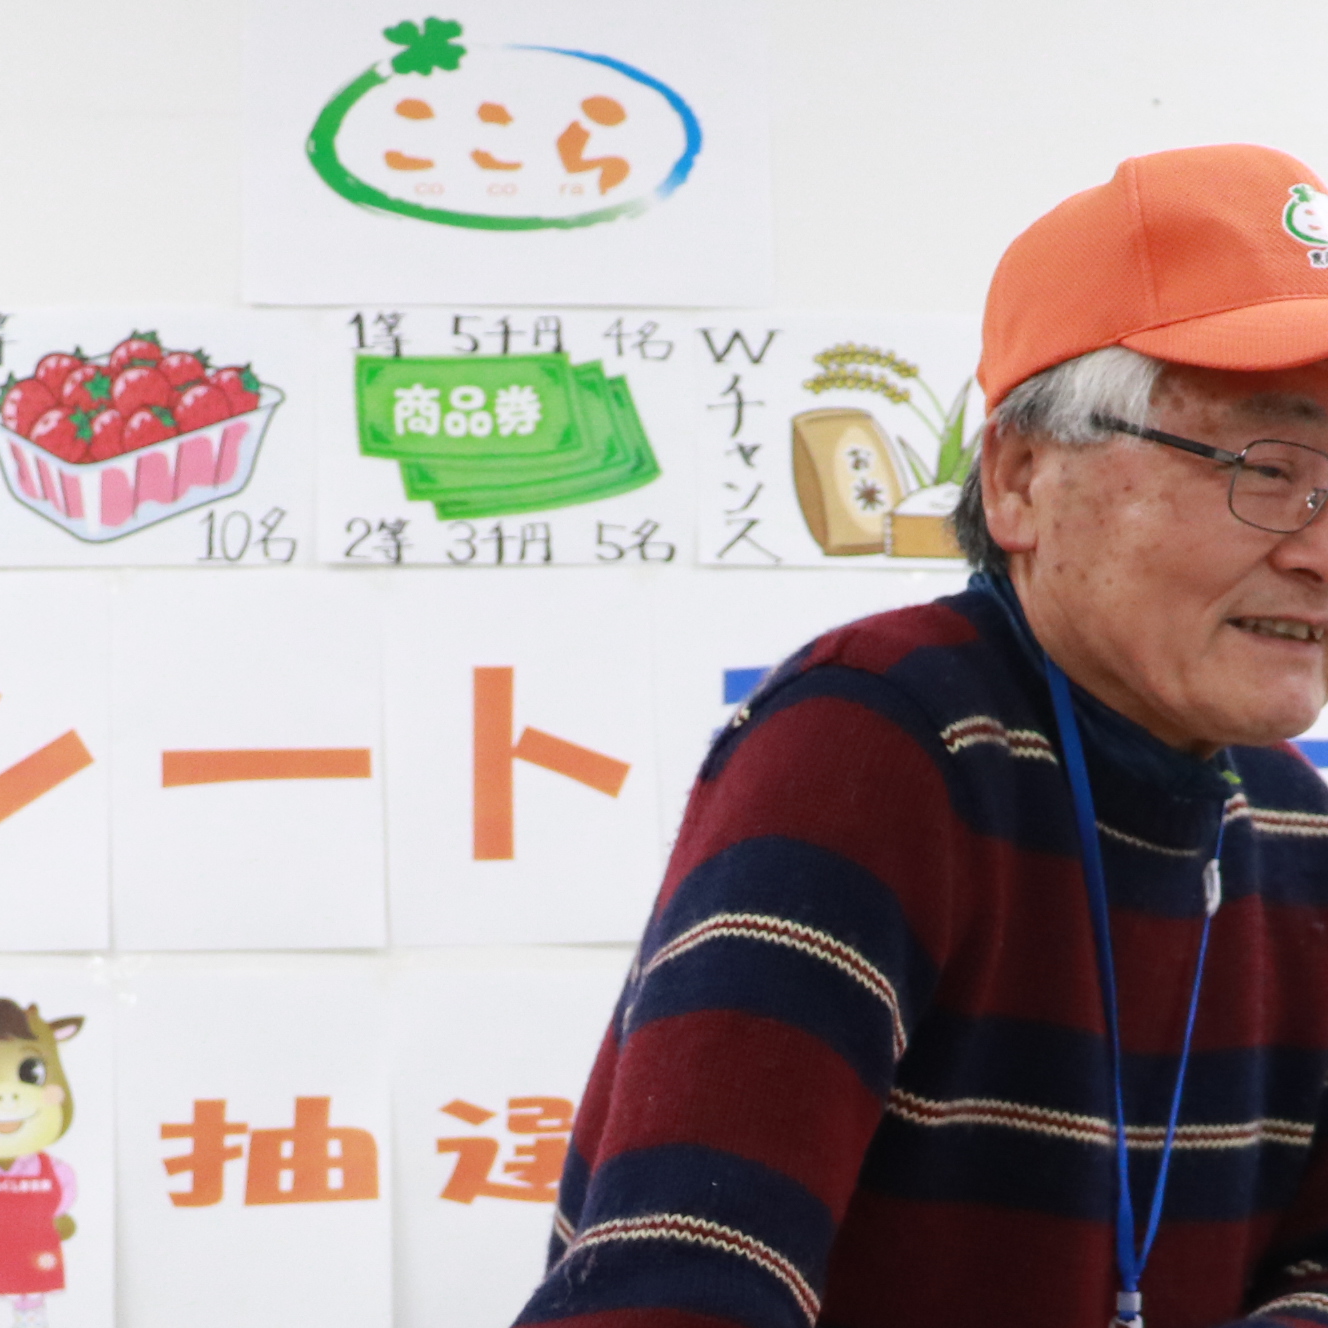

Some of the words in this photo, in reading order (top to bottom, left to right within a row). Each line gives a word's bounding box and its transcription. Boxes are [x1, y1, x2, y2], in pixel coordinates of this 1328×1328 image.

[383, 95, 630, 196] ここら
[414, 183, 445, 196] co
[486, 183, 518, 196] co
[348, 312, 410, 357] 1等
[451, 315, 563, 355] 5千円
[603, 317, 674, 360] 4名
[393, 383, 542, 437] 商品券
[197, 507, 297, 563] 10名
[344, 517, 413, 565] 2等
[447, 520, 553, 564] 3千円
[595, 519, 678, 563] 5名
